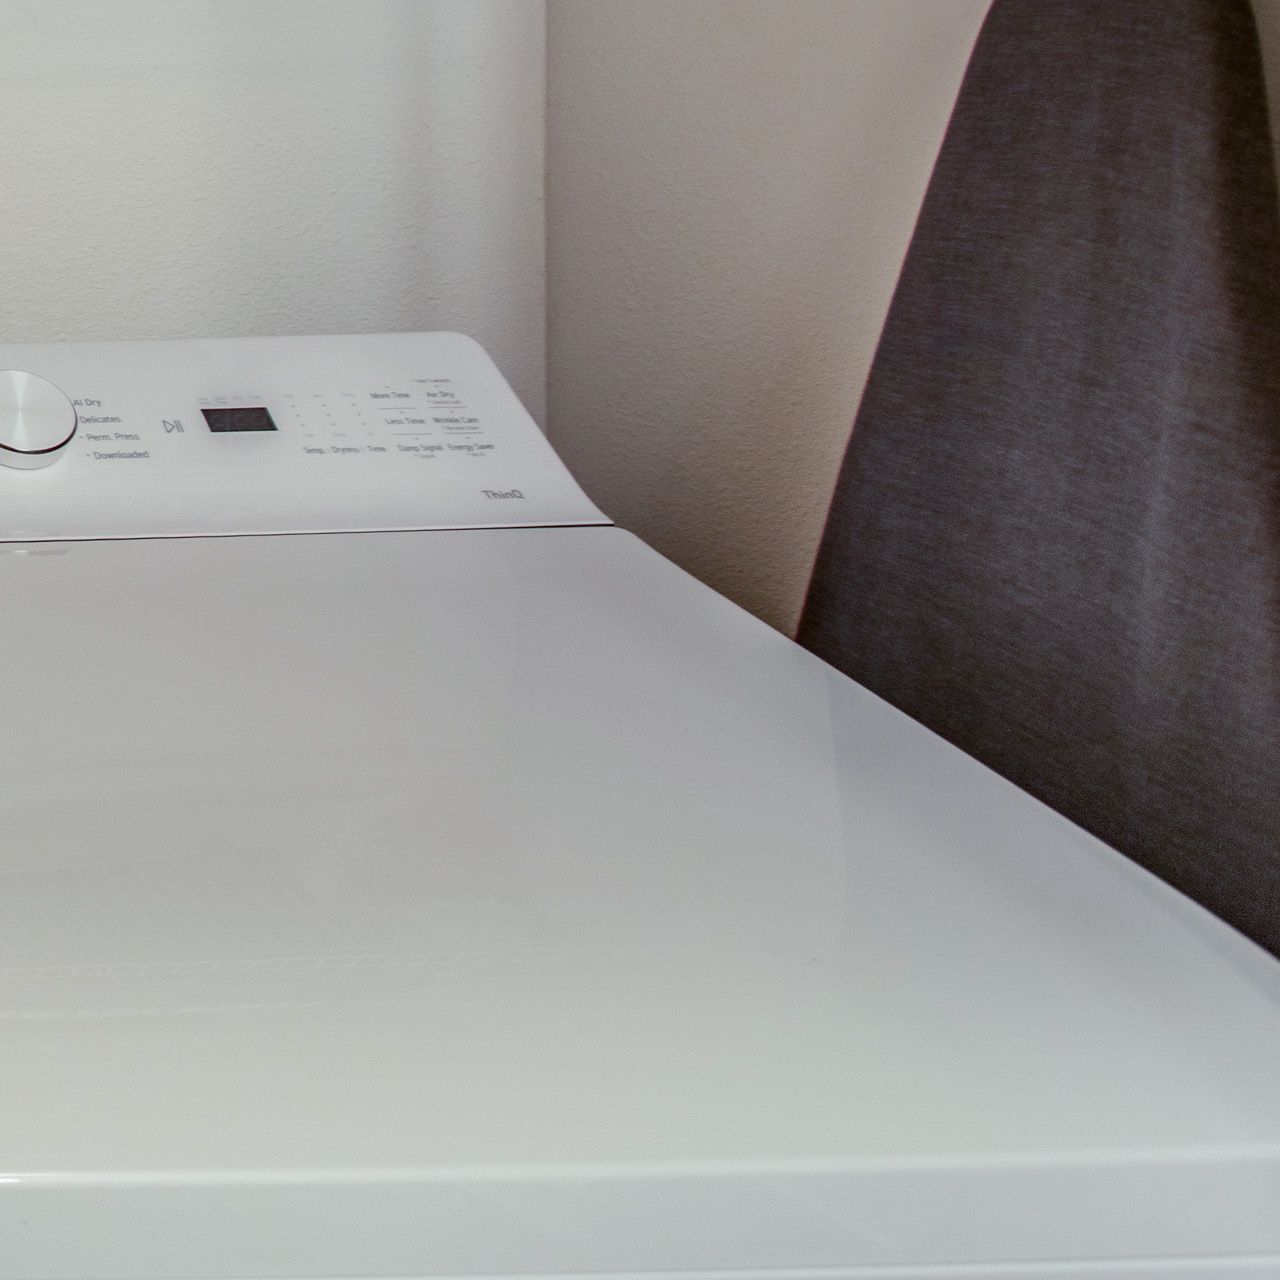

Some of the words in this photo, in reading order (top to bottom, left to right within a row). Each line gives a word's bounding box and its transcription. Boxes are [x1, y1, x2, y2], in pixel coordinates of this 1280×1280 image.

[85, 399, 101, 407] Dry
[79, 416, 122, 424] Delicates
[93, 451, 149, 460] Downloaded
[480, 489, 525, 500] ThinQ
